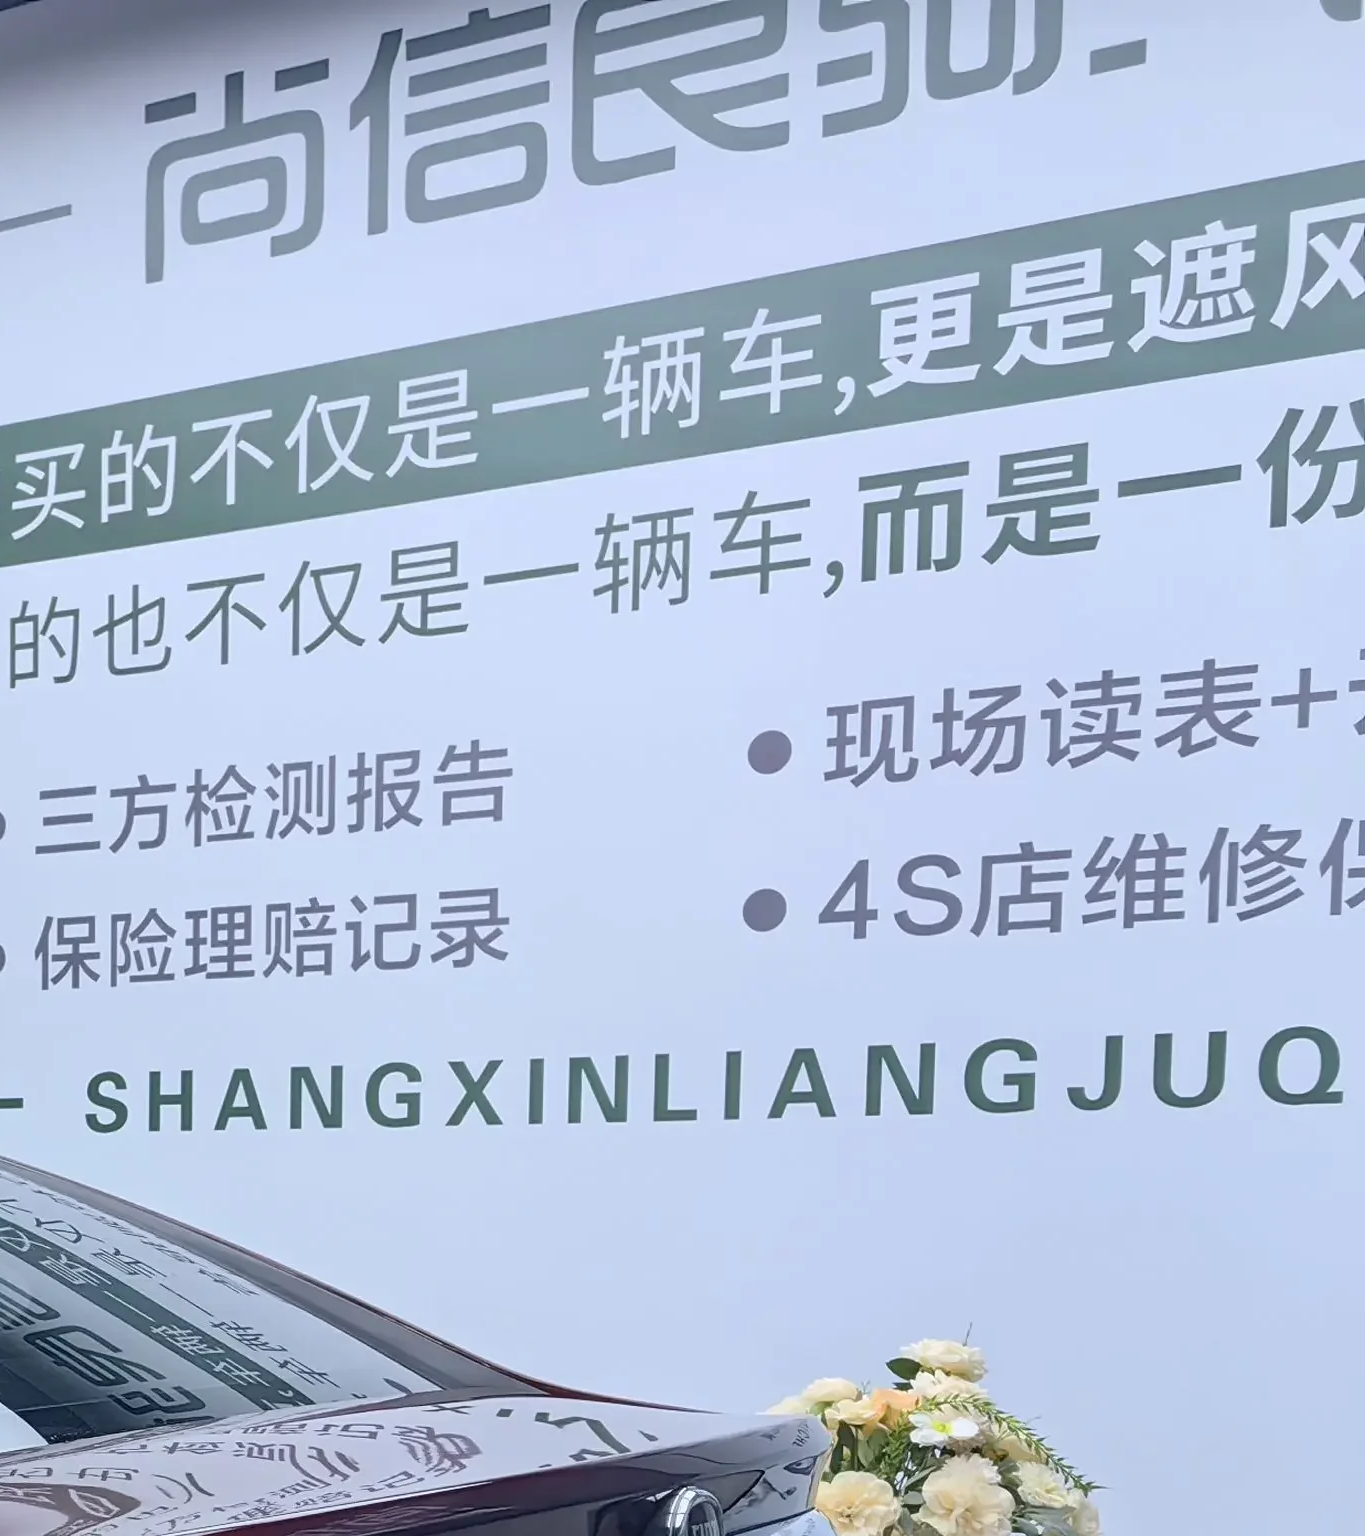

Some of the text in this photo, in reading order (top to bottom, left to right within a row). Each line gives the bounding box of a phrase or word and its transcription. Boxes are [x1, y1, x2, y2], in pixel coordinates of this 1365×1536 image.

[822, 648, 1365, 788] 现场读表+
[34, 739, 514, 856] 三方检测报告
[33, 887, 511, 991] 保险理赔记录
[84, 1025, 1345, 1134] SHANGXINLIANGJUQ
